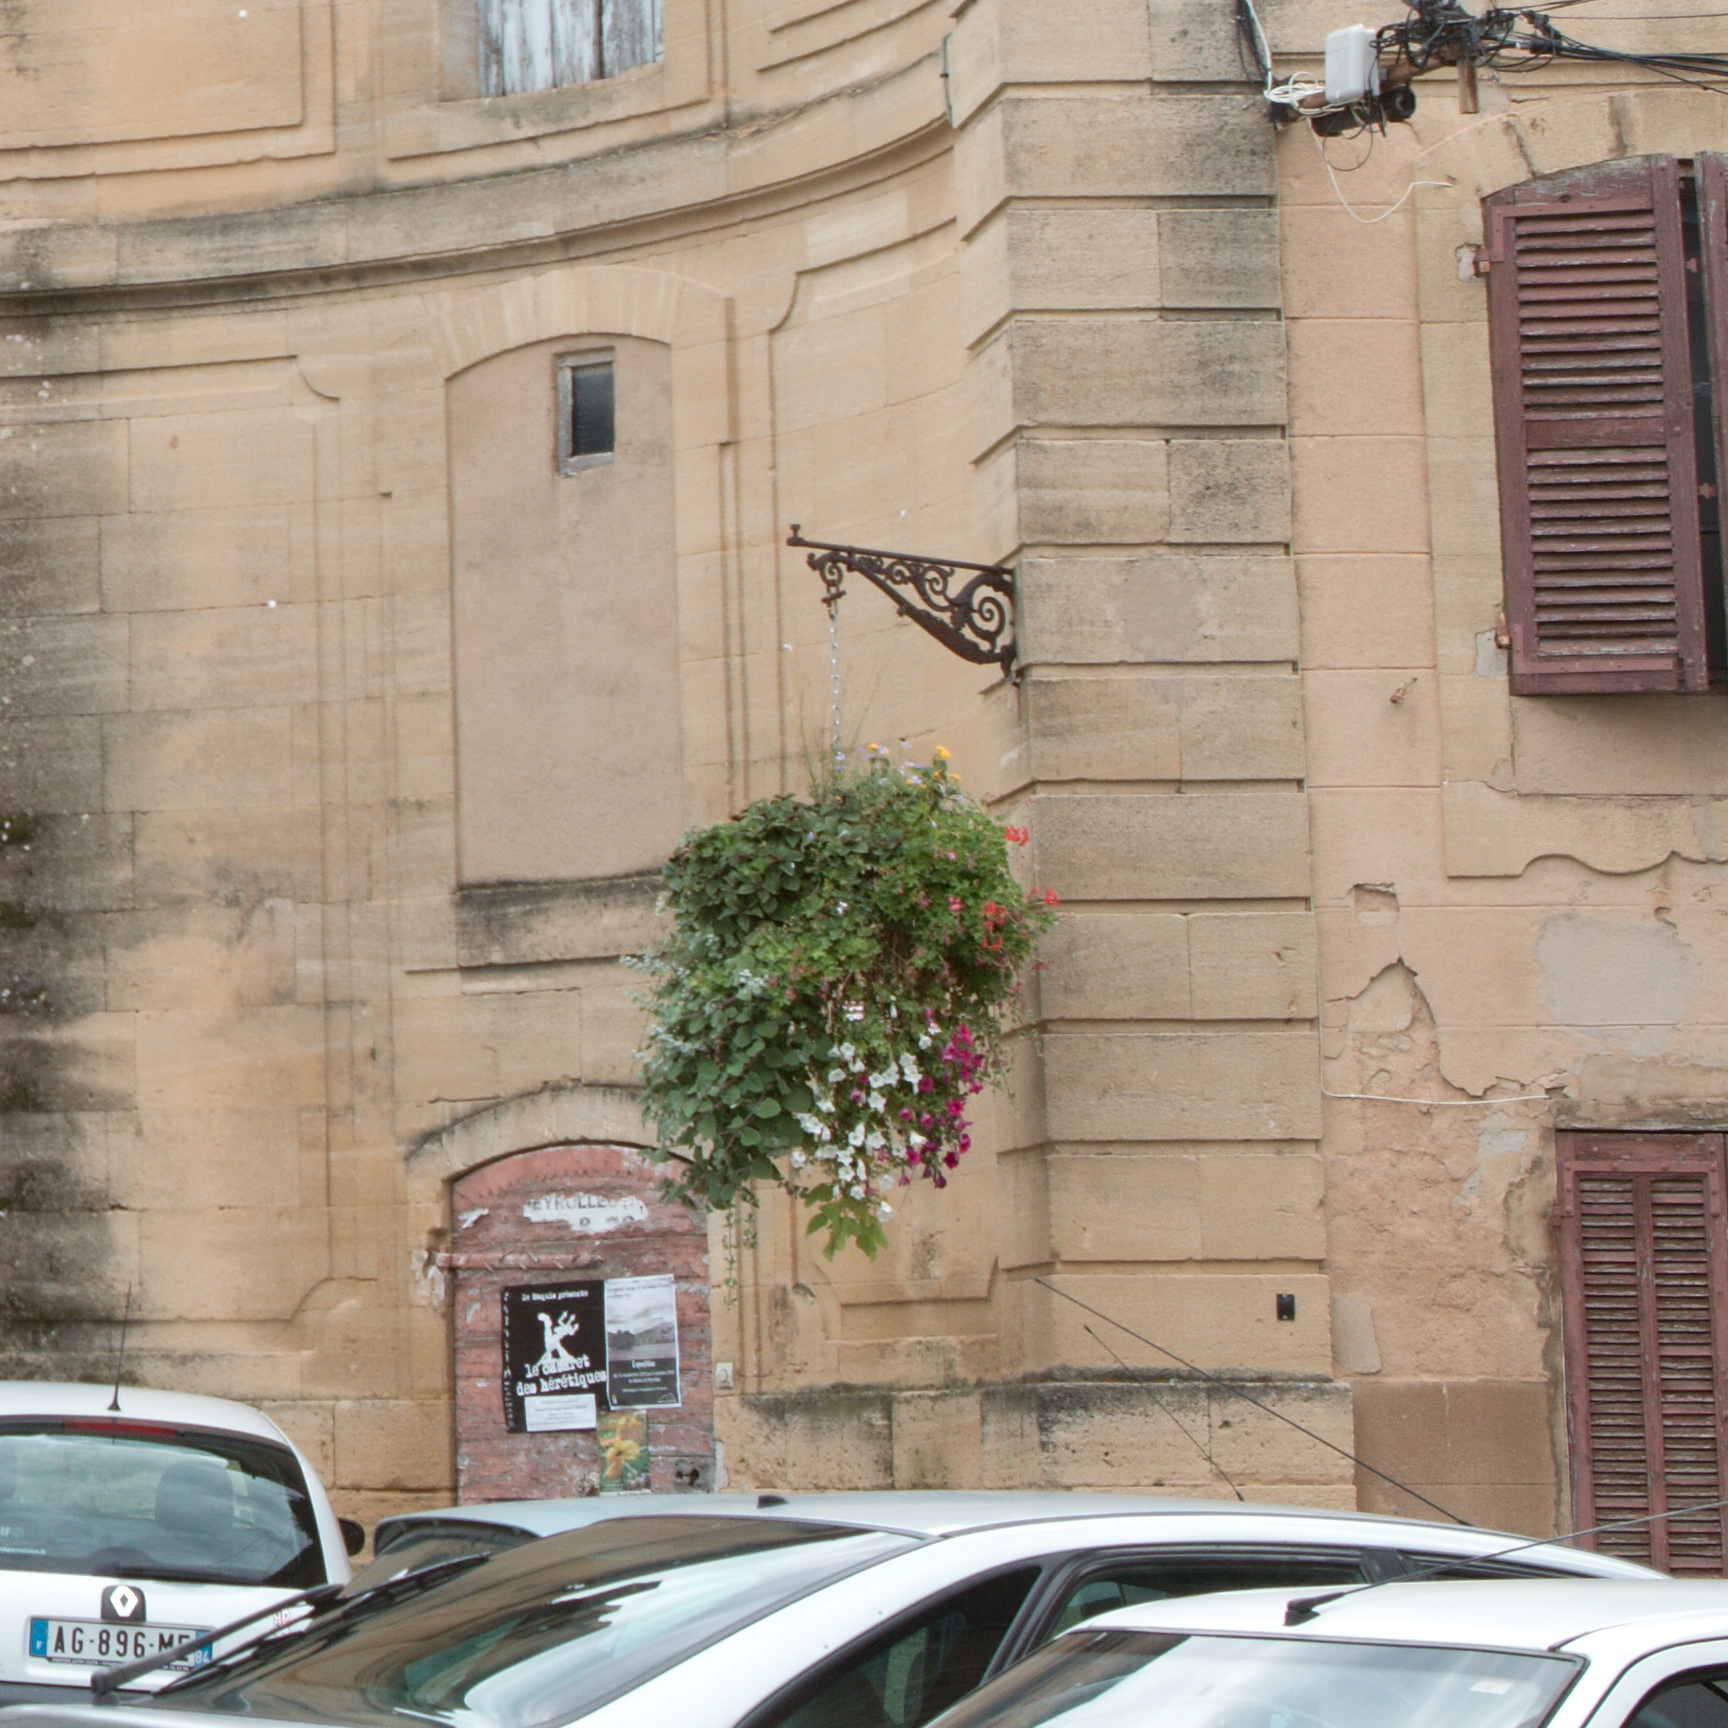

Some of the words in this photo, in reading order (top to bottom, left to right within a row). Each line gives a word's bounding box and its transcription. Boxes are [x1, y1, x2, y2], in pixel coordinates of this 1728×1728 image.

[524, 1363, 540, 1379] le
[516, 1380, 538, 1397] des
[539, 1370, 607, 1393] hérétiques
[194, 1649, 211, 1665] 84
